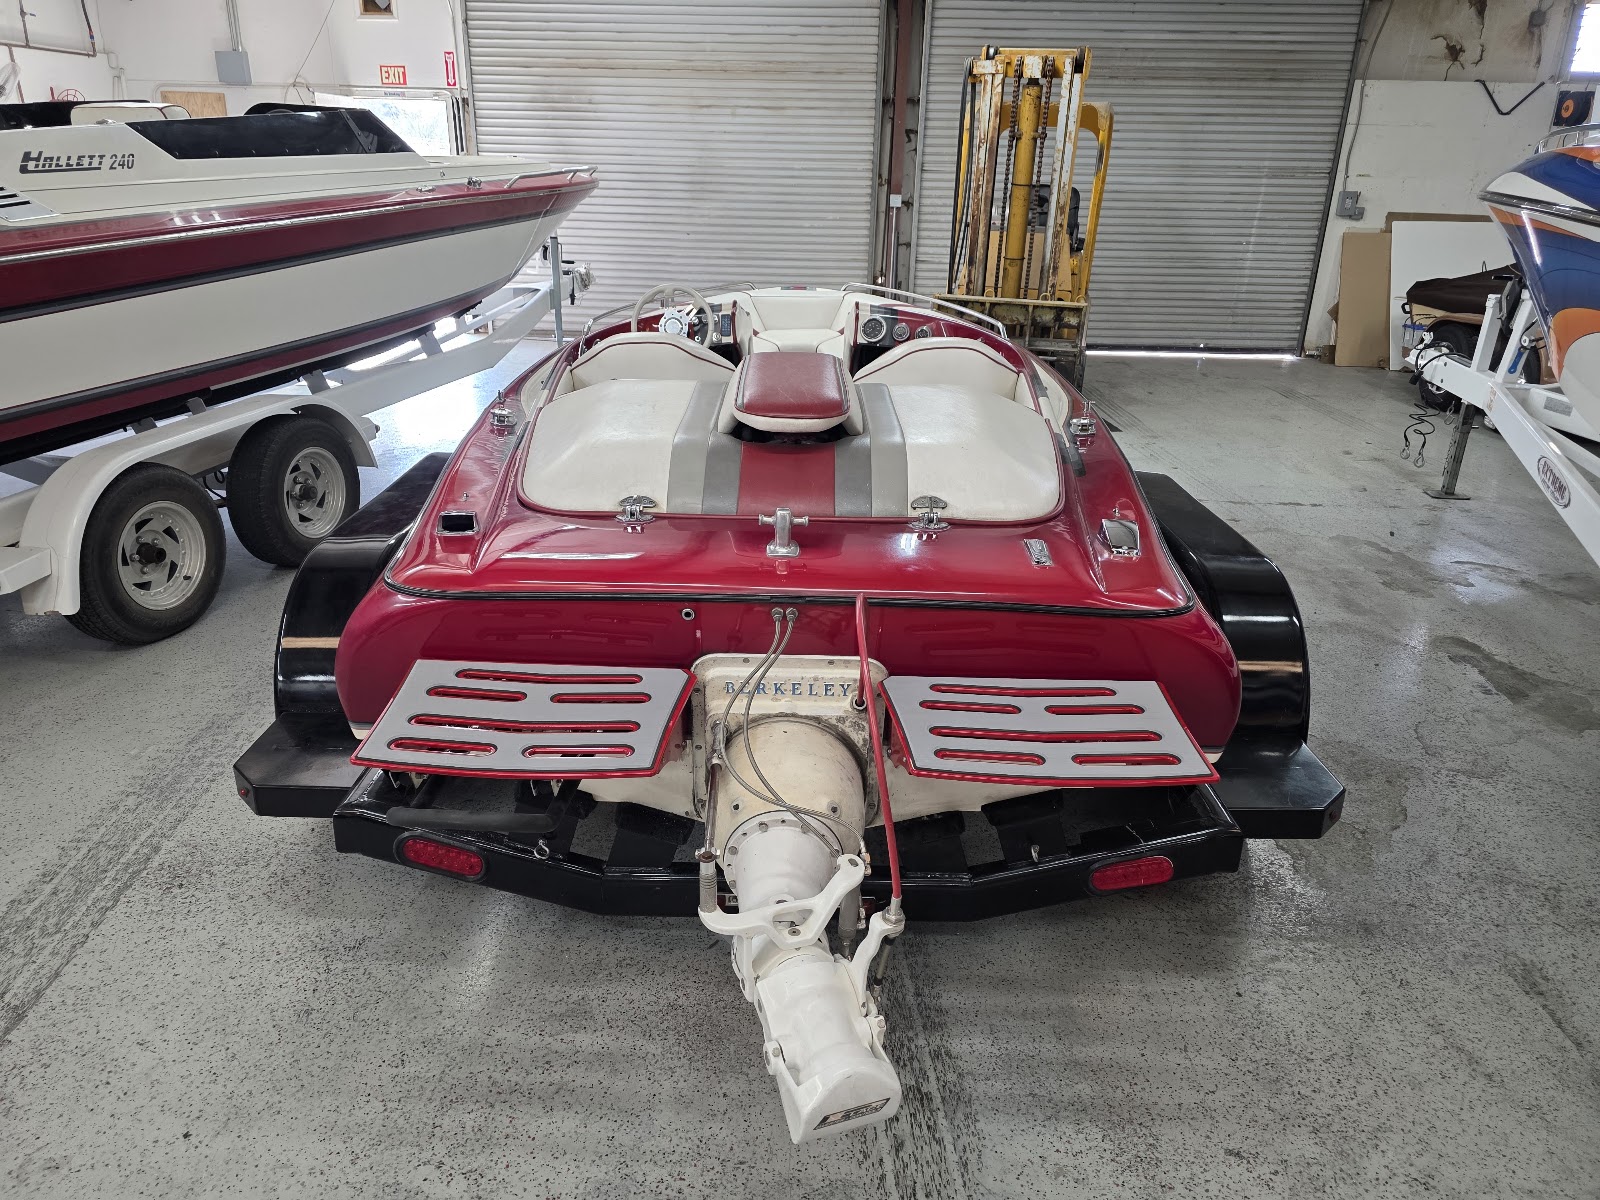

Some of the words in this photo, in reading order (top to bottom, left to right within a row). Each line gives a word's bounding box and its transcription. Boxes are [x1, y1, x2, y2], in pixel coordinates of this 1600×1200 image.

[381, 66, 405, 84] EXIT
[19, 151, 106, 174] HALLETT
[109, 153, 135, 171] 240
